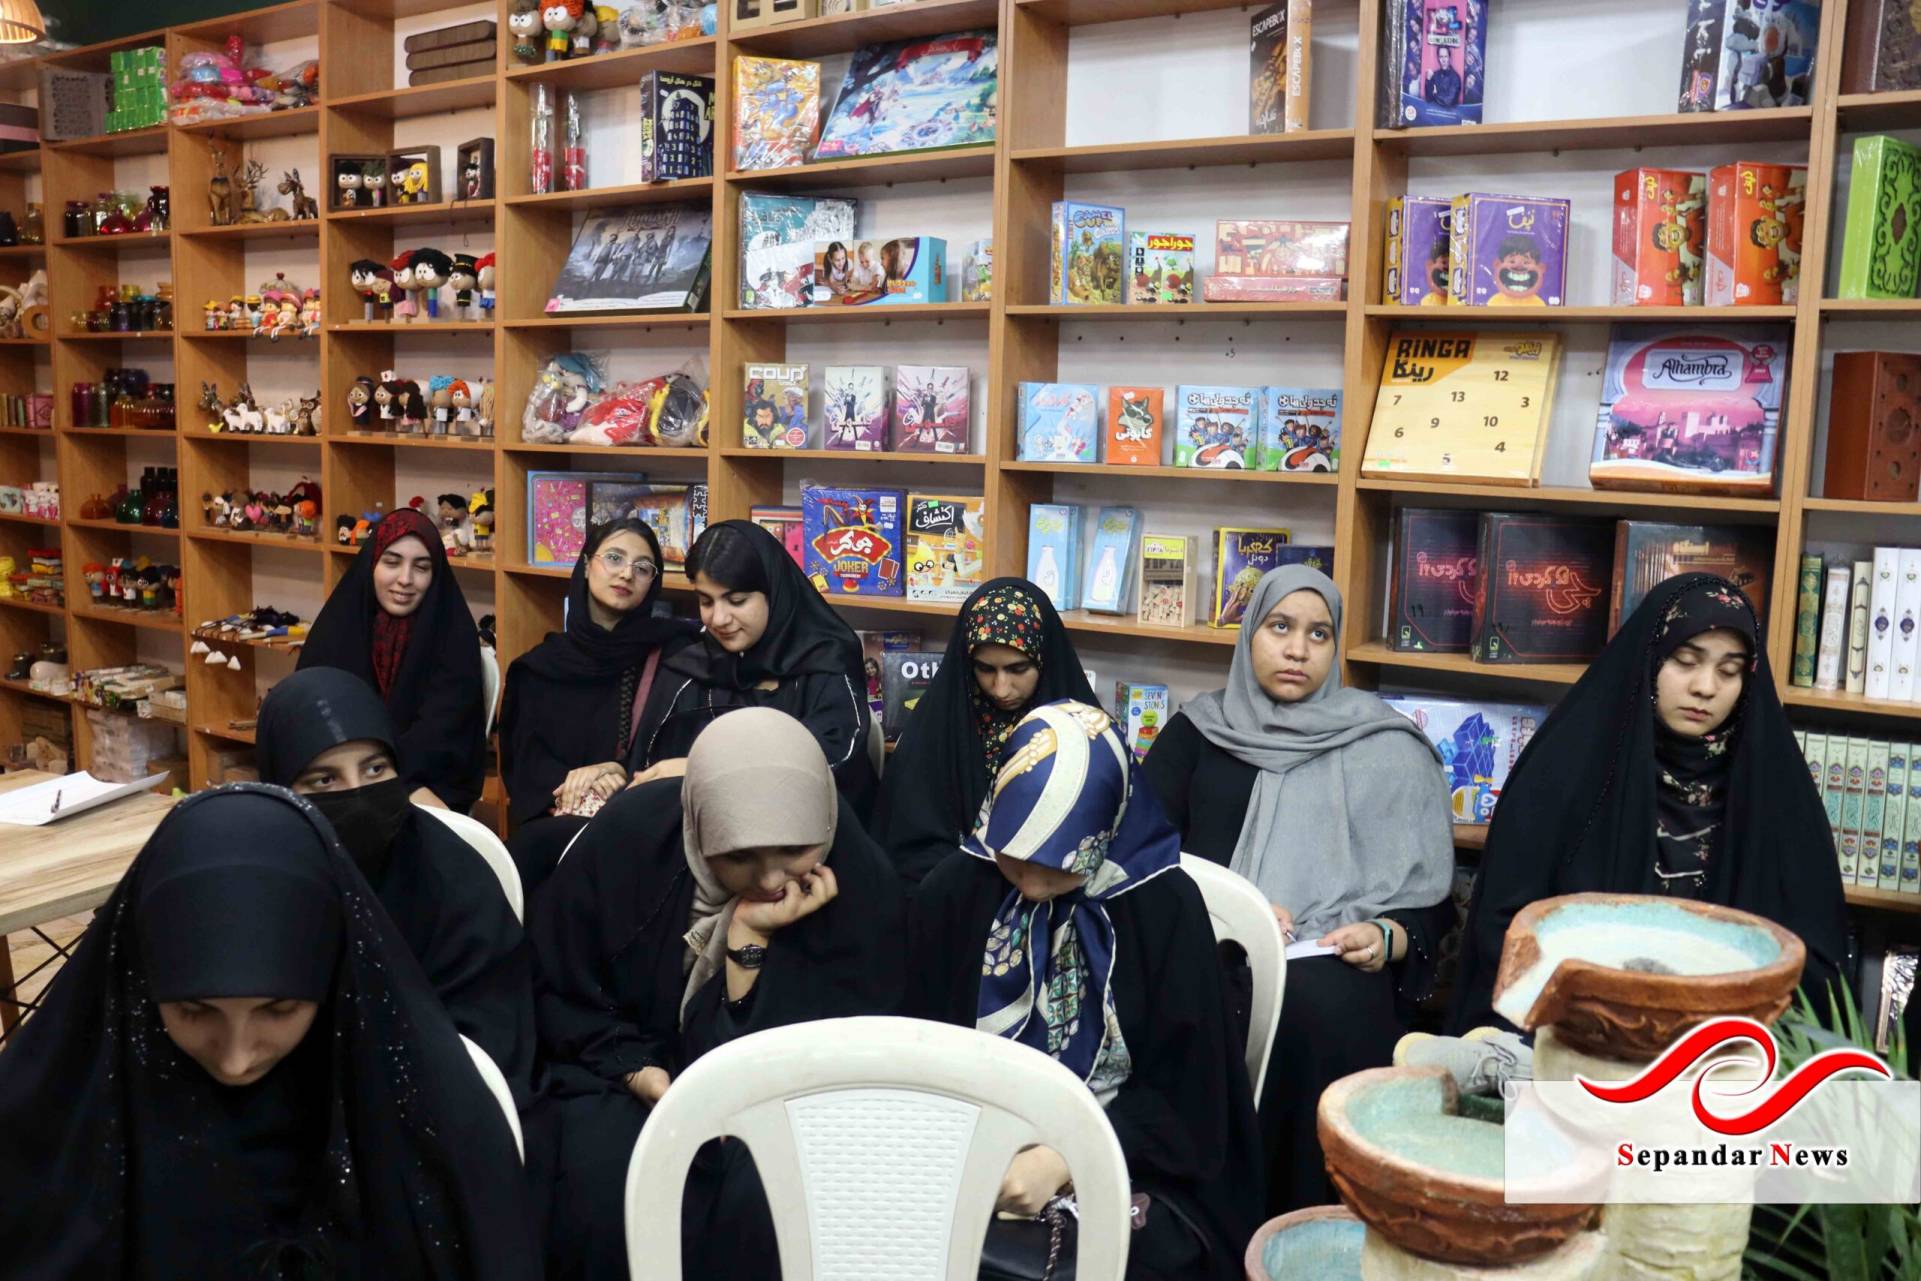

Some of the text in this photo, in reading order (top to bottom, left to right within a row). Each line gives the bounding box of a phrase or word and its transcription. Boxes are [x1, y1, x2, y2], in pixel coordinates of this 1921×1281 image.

[1148, 236, 1193, 250] جوراجور
[1397, 339, 1471, 358] RINGA
[1653, 354, 1733, 385] Alhambra
[1494, 370, 1509, 381] 12
[1393, 395, 1402, 406] 7
[1451, 391, 1466, 402] 13
[1521, 397, 1530, 408] 3
[1430, 418, 1440, 428] 9
[1483, 416, 1499, 427] 10
[1394, 427, 1404, 438] 6
[1494, 441, 1506, 452] 4
[915, 504, 955, 528] اکتشاف
[830, 530, 874, 556] جوکر
[833, 560, 869, 573] JOKER
